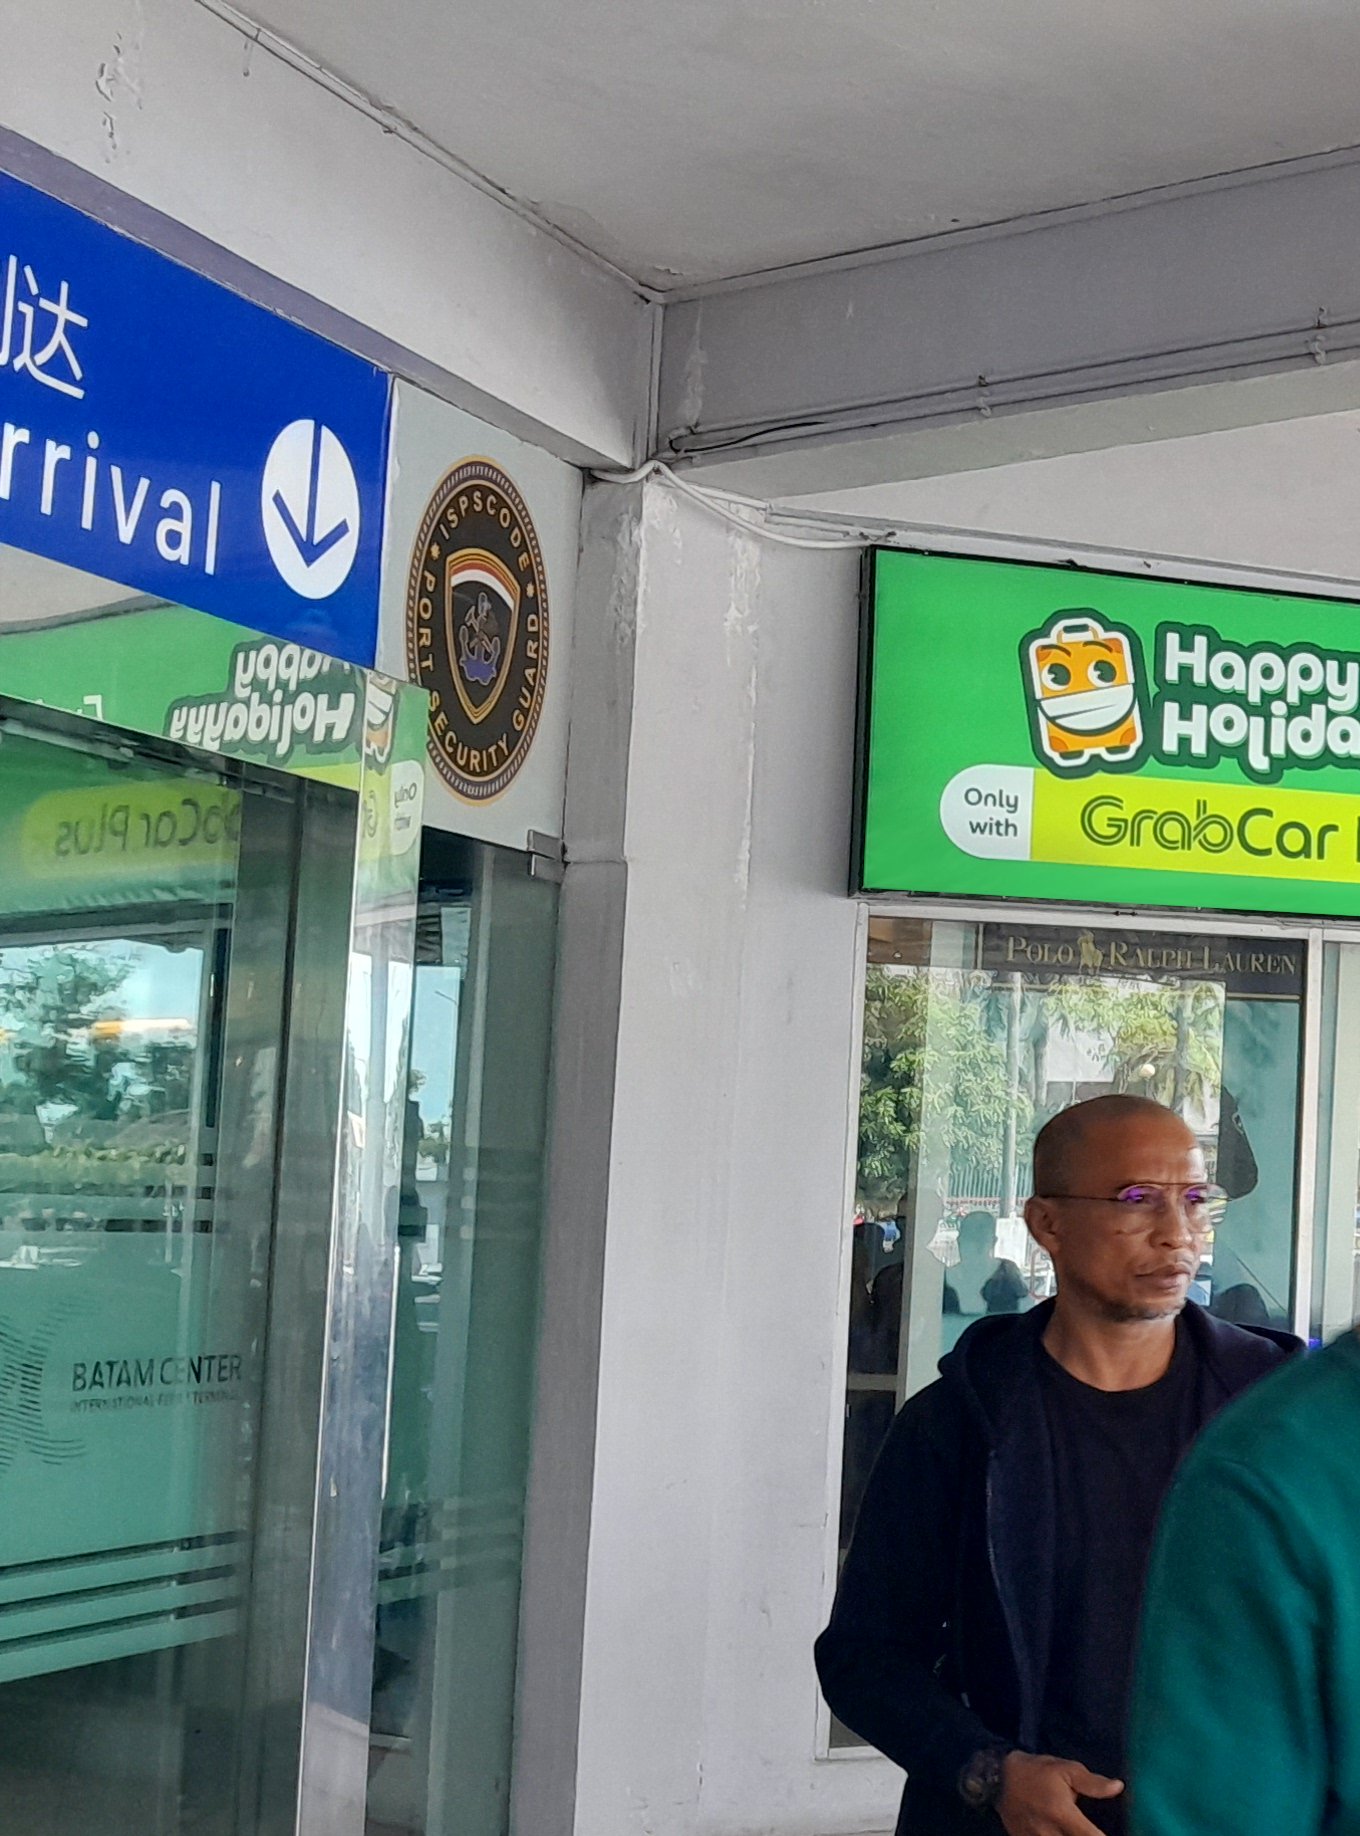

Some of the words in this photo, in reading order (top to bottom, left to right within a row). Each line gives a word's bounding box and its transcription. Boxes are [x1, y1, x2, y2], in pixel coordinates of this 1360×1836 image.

[418, 570, 436, 672] PORT
[512, 613, 539, 731] GUARD
[1163, 631, 1360, 714] Happy
[429, 690, 510, 773] SECURITY
[963, 786, 1019, 815] Only
[968, 815, 1018, 839] with
[1079, 795, 1339, 861] GrabCar
[1202, 945, 1297, 976] LAUREN
[72, 1359, 155, 1392] BATAM
[159, 1354, 243, 1386] CENTER
